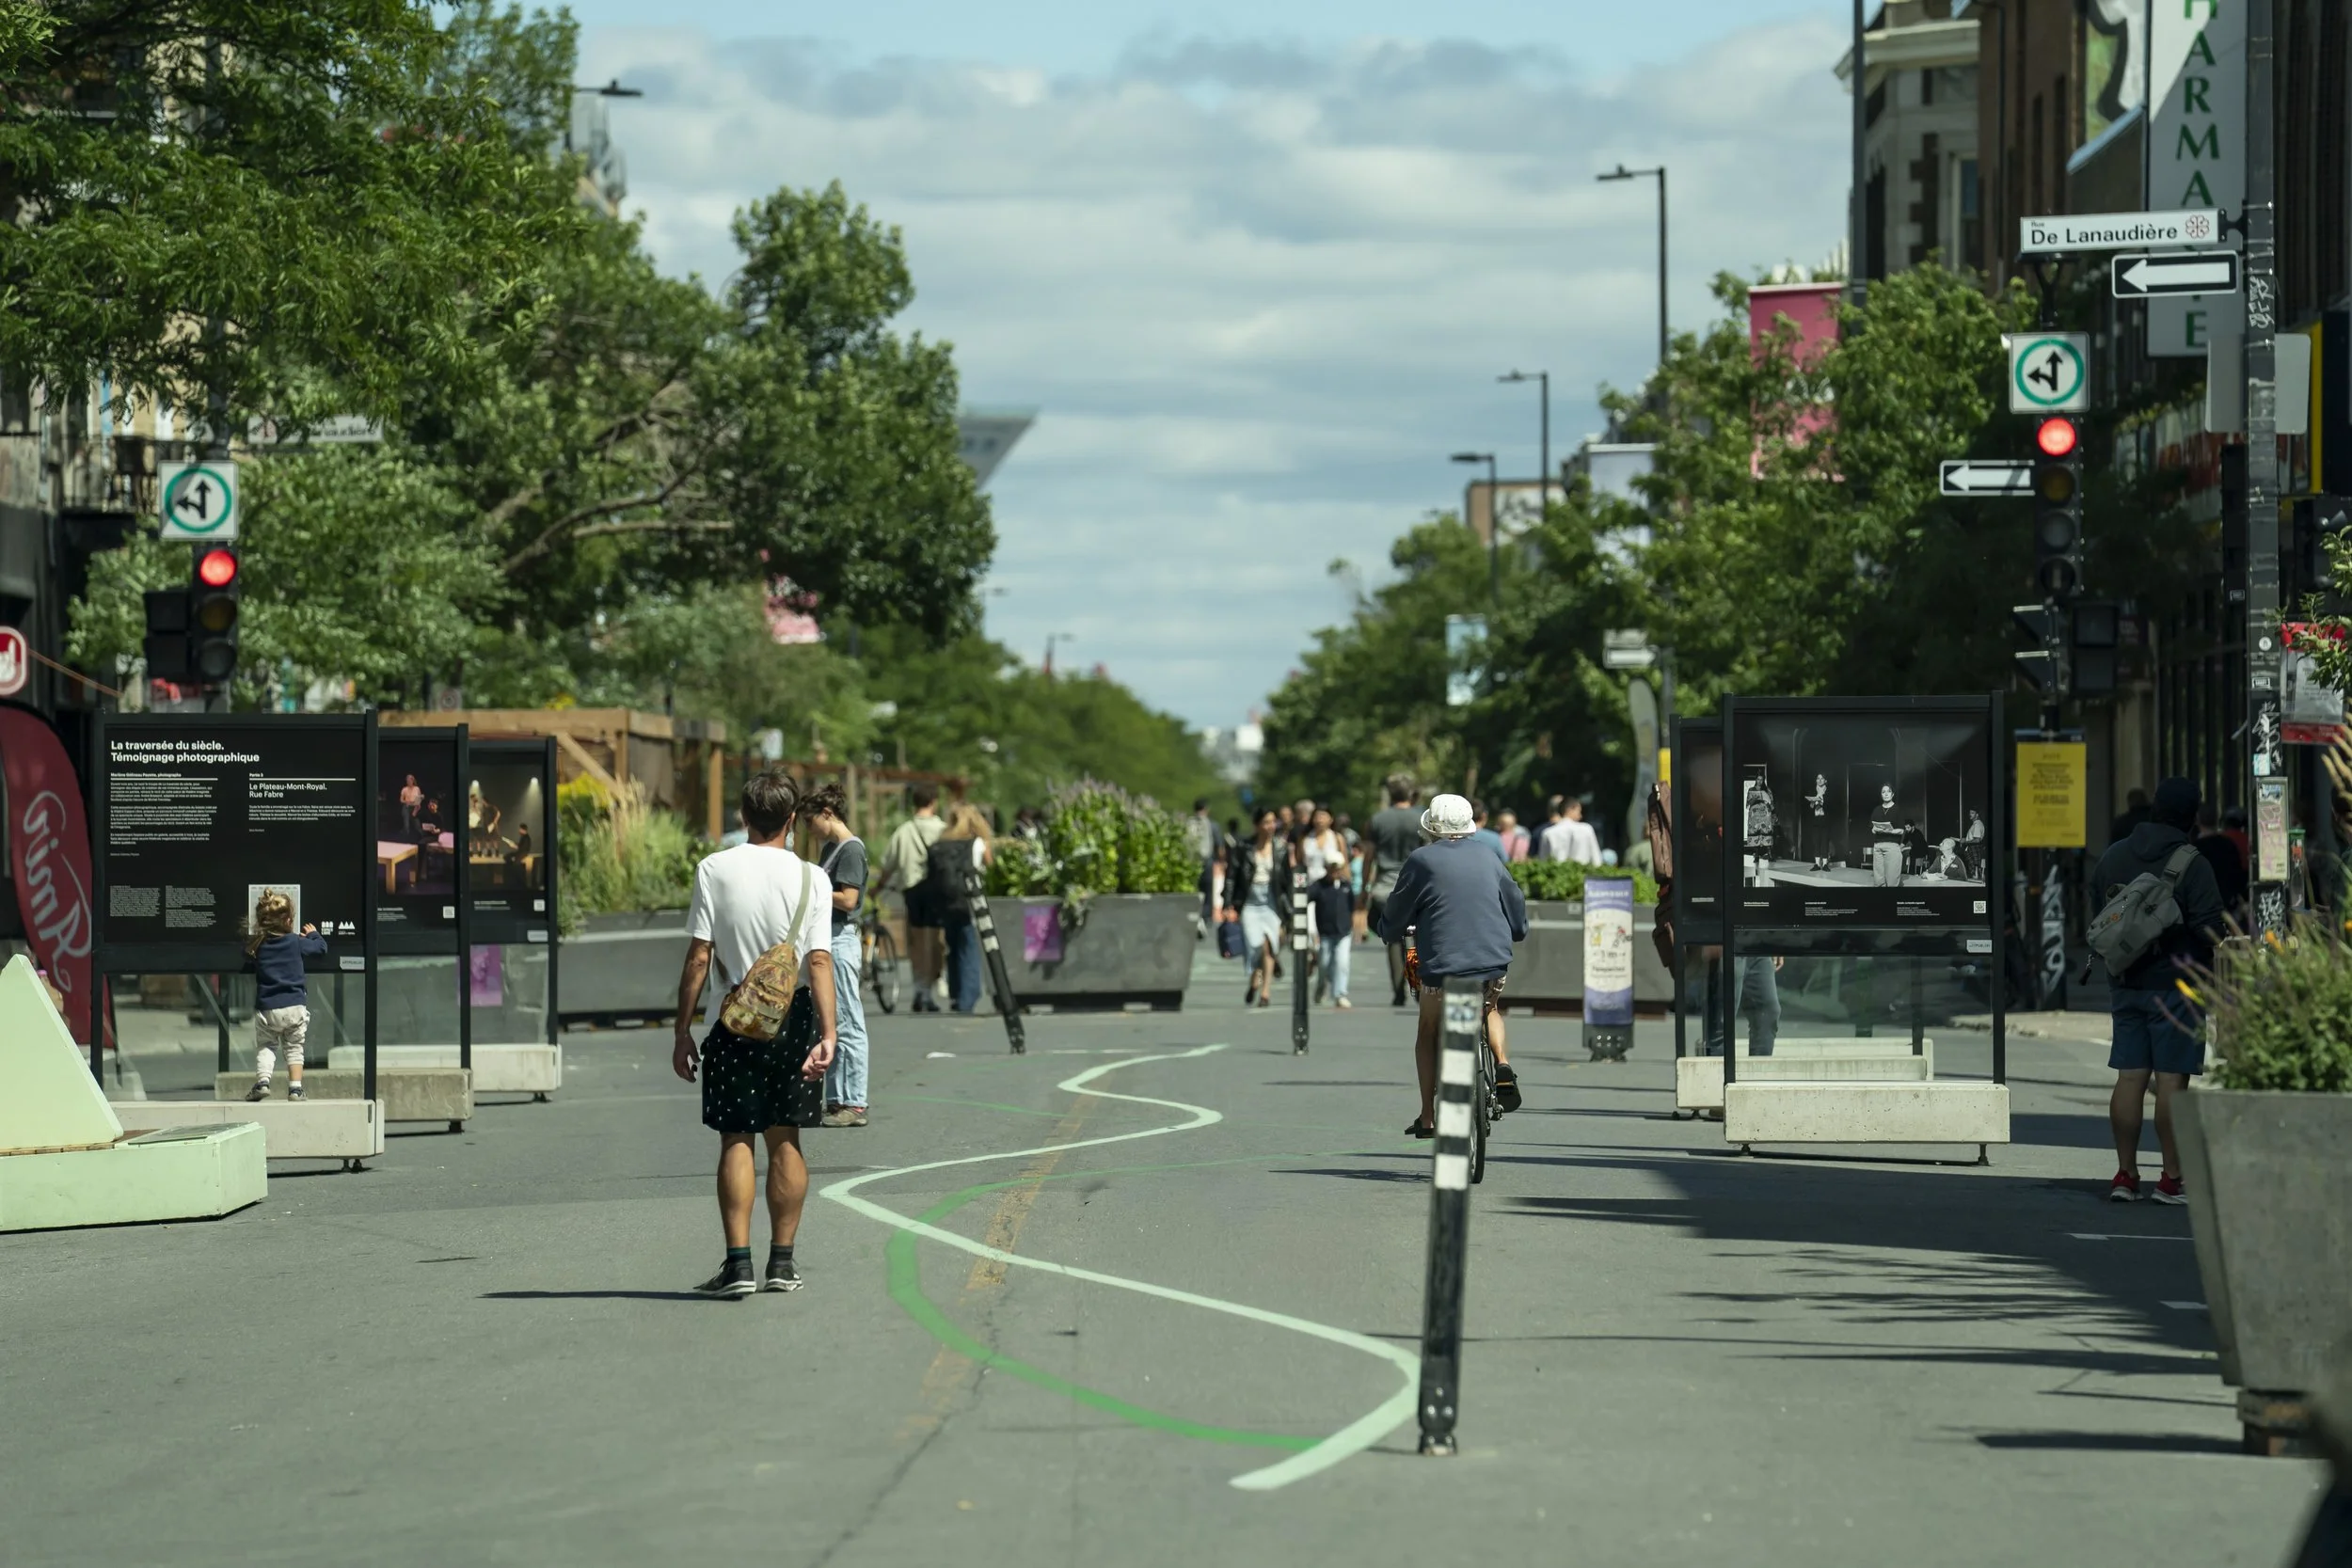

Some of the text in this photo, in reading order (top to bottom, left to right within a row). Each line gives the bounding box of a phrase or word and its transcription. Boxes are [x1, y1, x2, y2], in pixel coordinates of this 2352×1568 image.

[2031, 224, 2178, 245] De Lanaudière
[111, 740, 225, 751] La traversée du siècle.
[111, 752, 261, 764] Témoignage photographique
[259, 783, 327, 791] Plateau-Mont-Royal.
